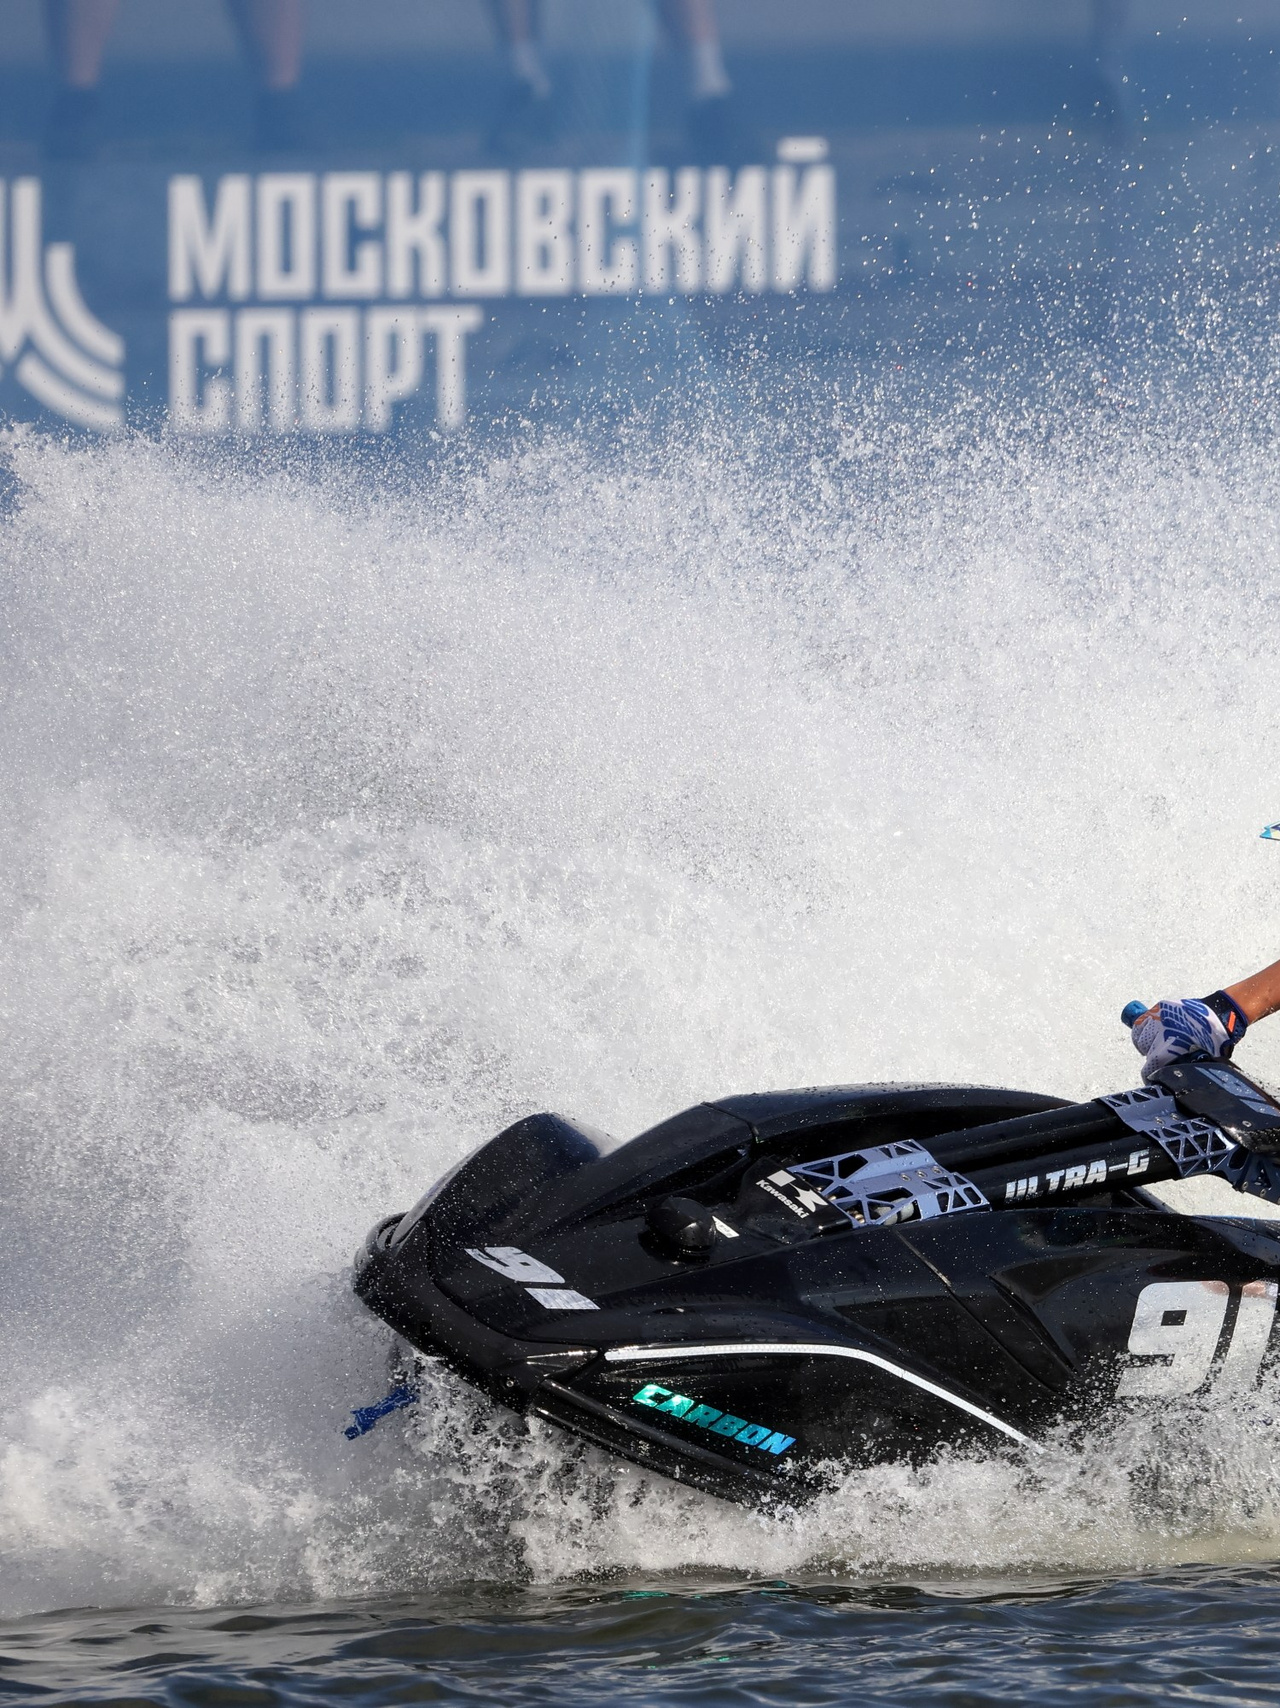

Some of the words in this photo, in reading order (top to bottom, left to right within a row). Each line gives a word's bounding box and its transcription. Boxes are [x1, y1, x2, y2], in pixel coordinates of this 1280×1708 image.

[168, 137, 837, 300] МОСКОВСКИЙ
[168, 305, 484, 434] СПОРТ
[755, 1179, 810, 1219] Kawasaki
[464, 1246, 601, 1310] 91
[1115, 1280, 1279, 1398] 91
[632, 1383, 797, 1456] CARBON
